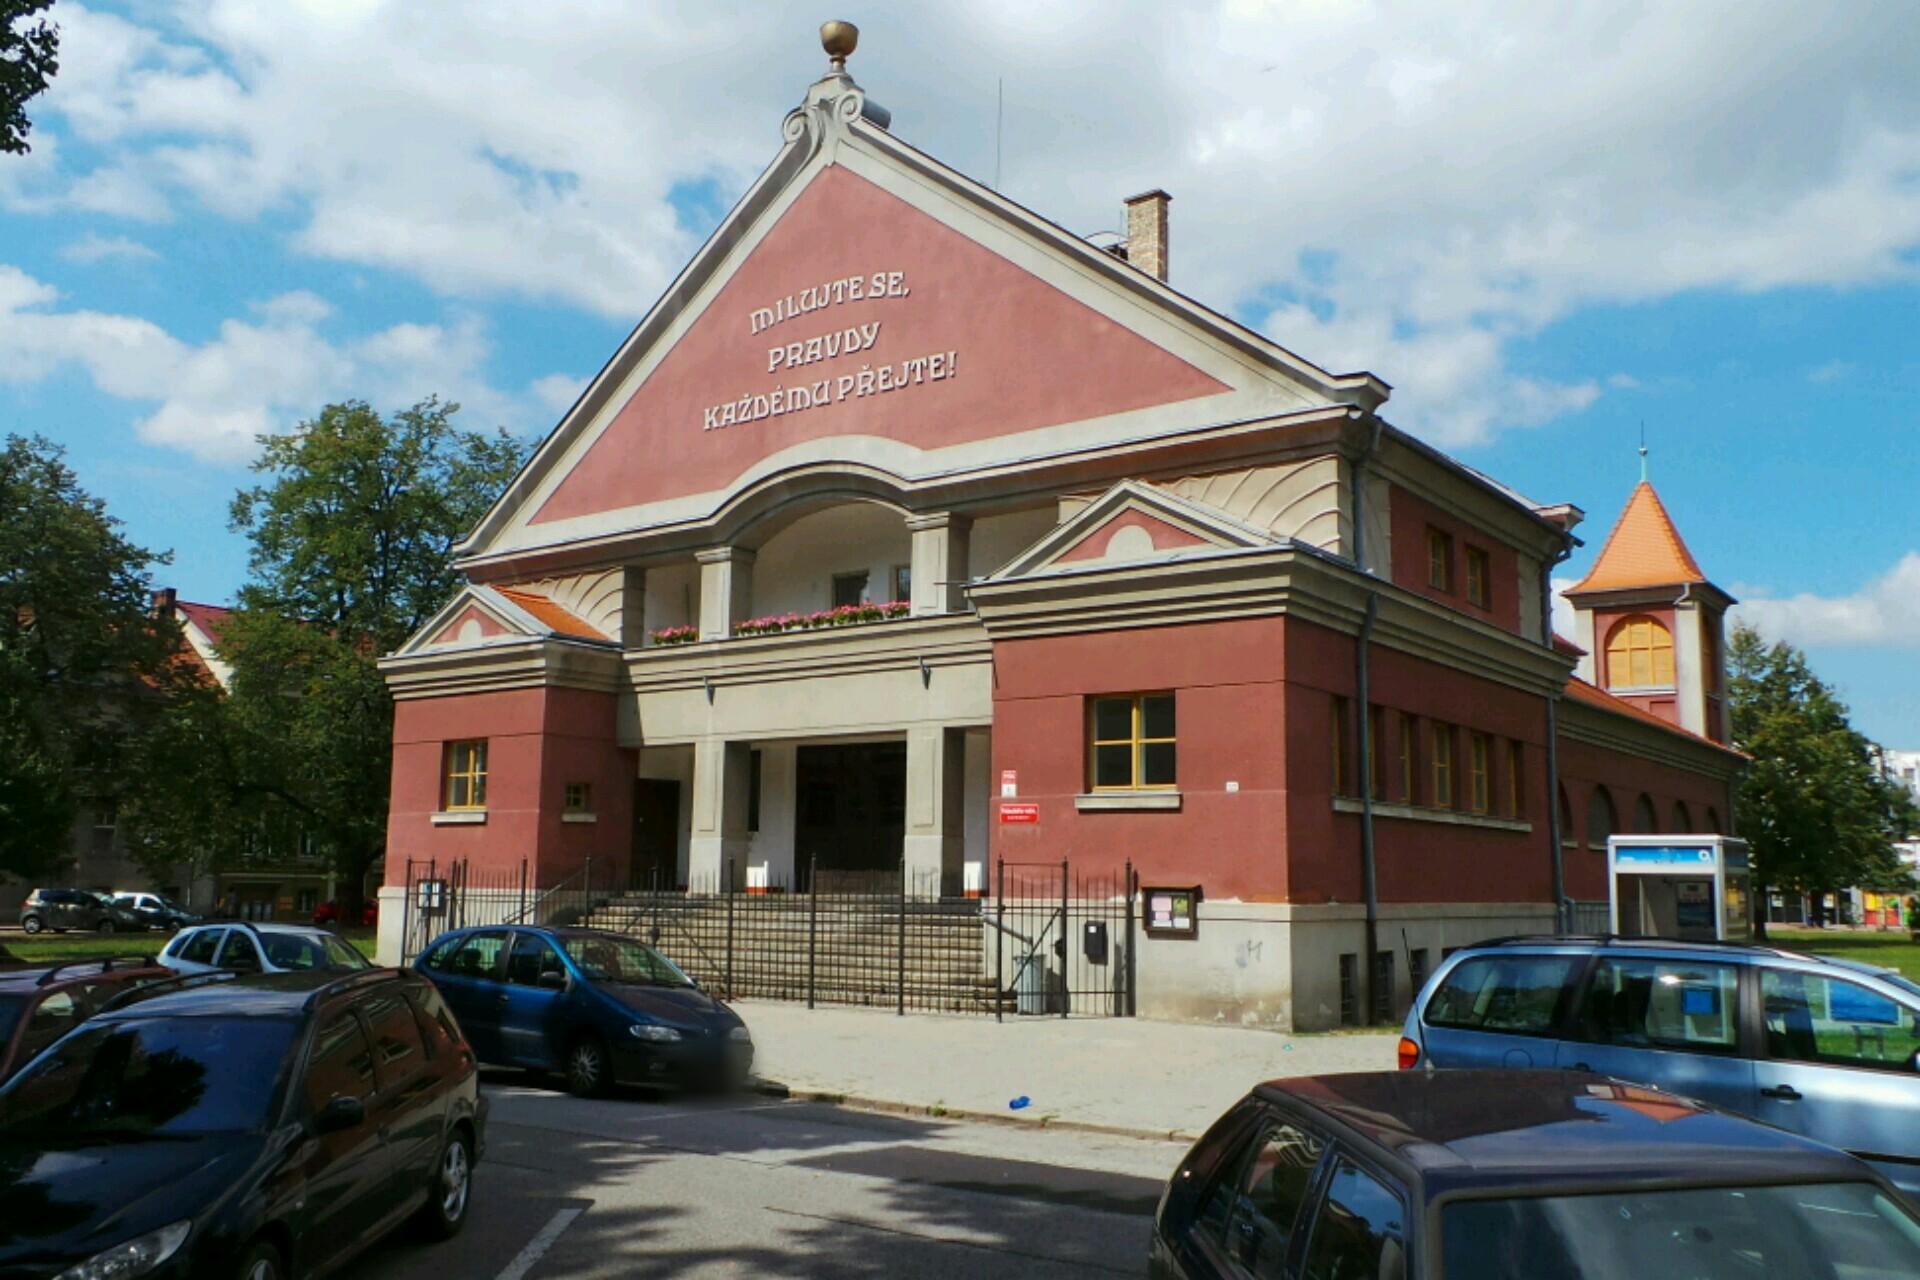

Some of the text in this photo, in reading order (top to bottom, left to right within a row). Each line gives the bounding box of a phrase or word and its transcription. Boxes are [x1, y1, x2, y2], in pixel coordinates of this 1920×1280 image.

[749, 275, 865, 335] MILUJTE
[767, 321, 881, 373] PRAVDY
[703, 351, 957, 431] KAŽDÉMU PŘEJTE!
